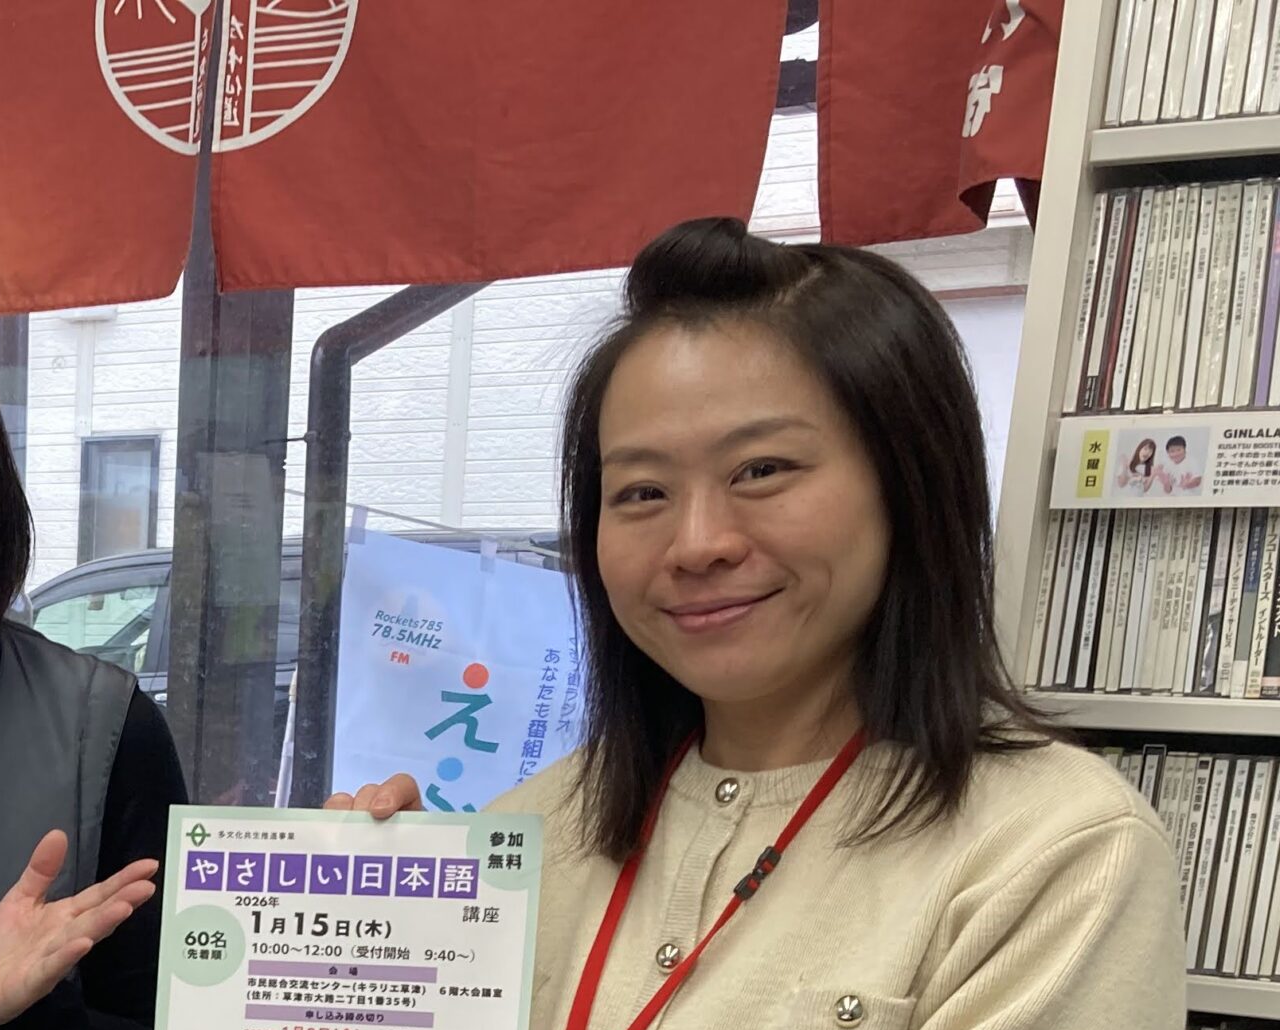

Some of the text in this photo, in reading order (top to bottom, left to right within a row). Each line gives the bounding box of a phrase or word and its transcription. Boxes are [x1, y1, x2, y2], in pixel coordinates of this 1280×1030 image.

[1084, 441, 1102, 488] 水曜日
[375, 610, 443, 632] Rockets785
[371, 623, 442, 650] 78.5MHz
[389, 651, 410, 665] FM
[515, 648, 560, 785] あなたも番組に
[217, 830, 294, 840] 多文化共生推進事業
[489, 831, 524, 847] 参加
[487, 853, 522, 870] 無料
[190, 855, 475, 894] やさしい日本語
[235, 895, 279, 907] 2026年
[462, 905, 500, 923] 講座
[250, 910, 392, 938] 1月15日(木)
[184, 931, 227, 948] 60名
[305, 1010, 384, 1023] 申し込み締め切り
